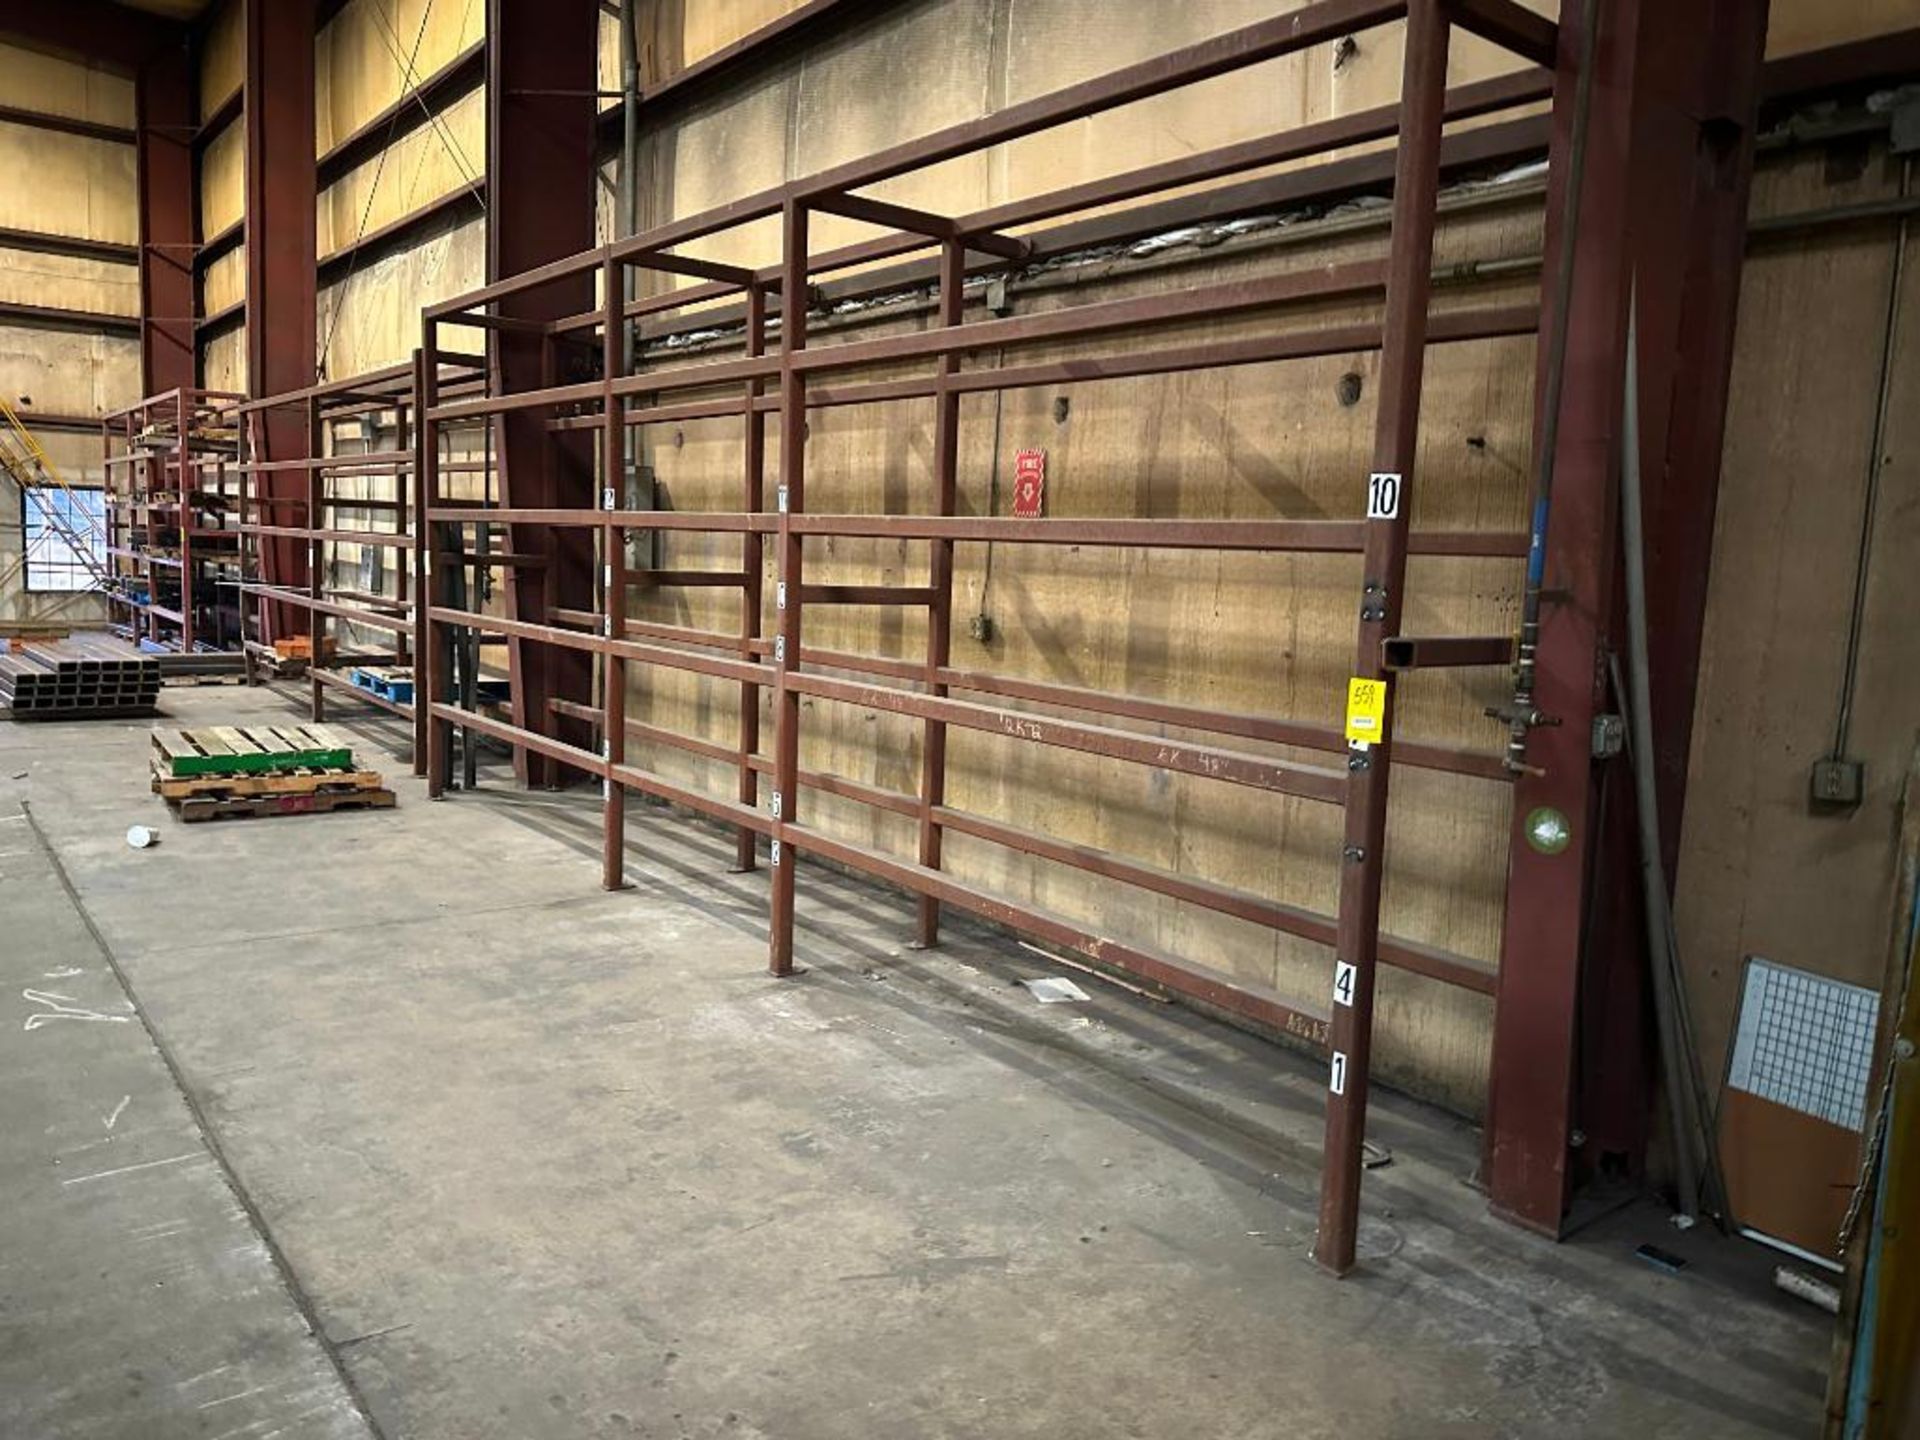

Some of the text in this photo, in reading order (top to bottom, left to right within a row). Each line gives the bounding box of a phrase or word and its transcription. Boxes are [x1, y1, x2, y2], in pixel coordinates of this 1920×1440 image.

[1372, 477, 1397, 516] 10
[1337, 967, 1351, 1002] 4
[1335, 1057, 1342, 1091] 1
